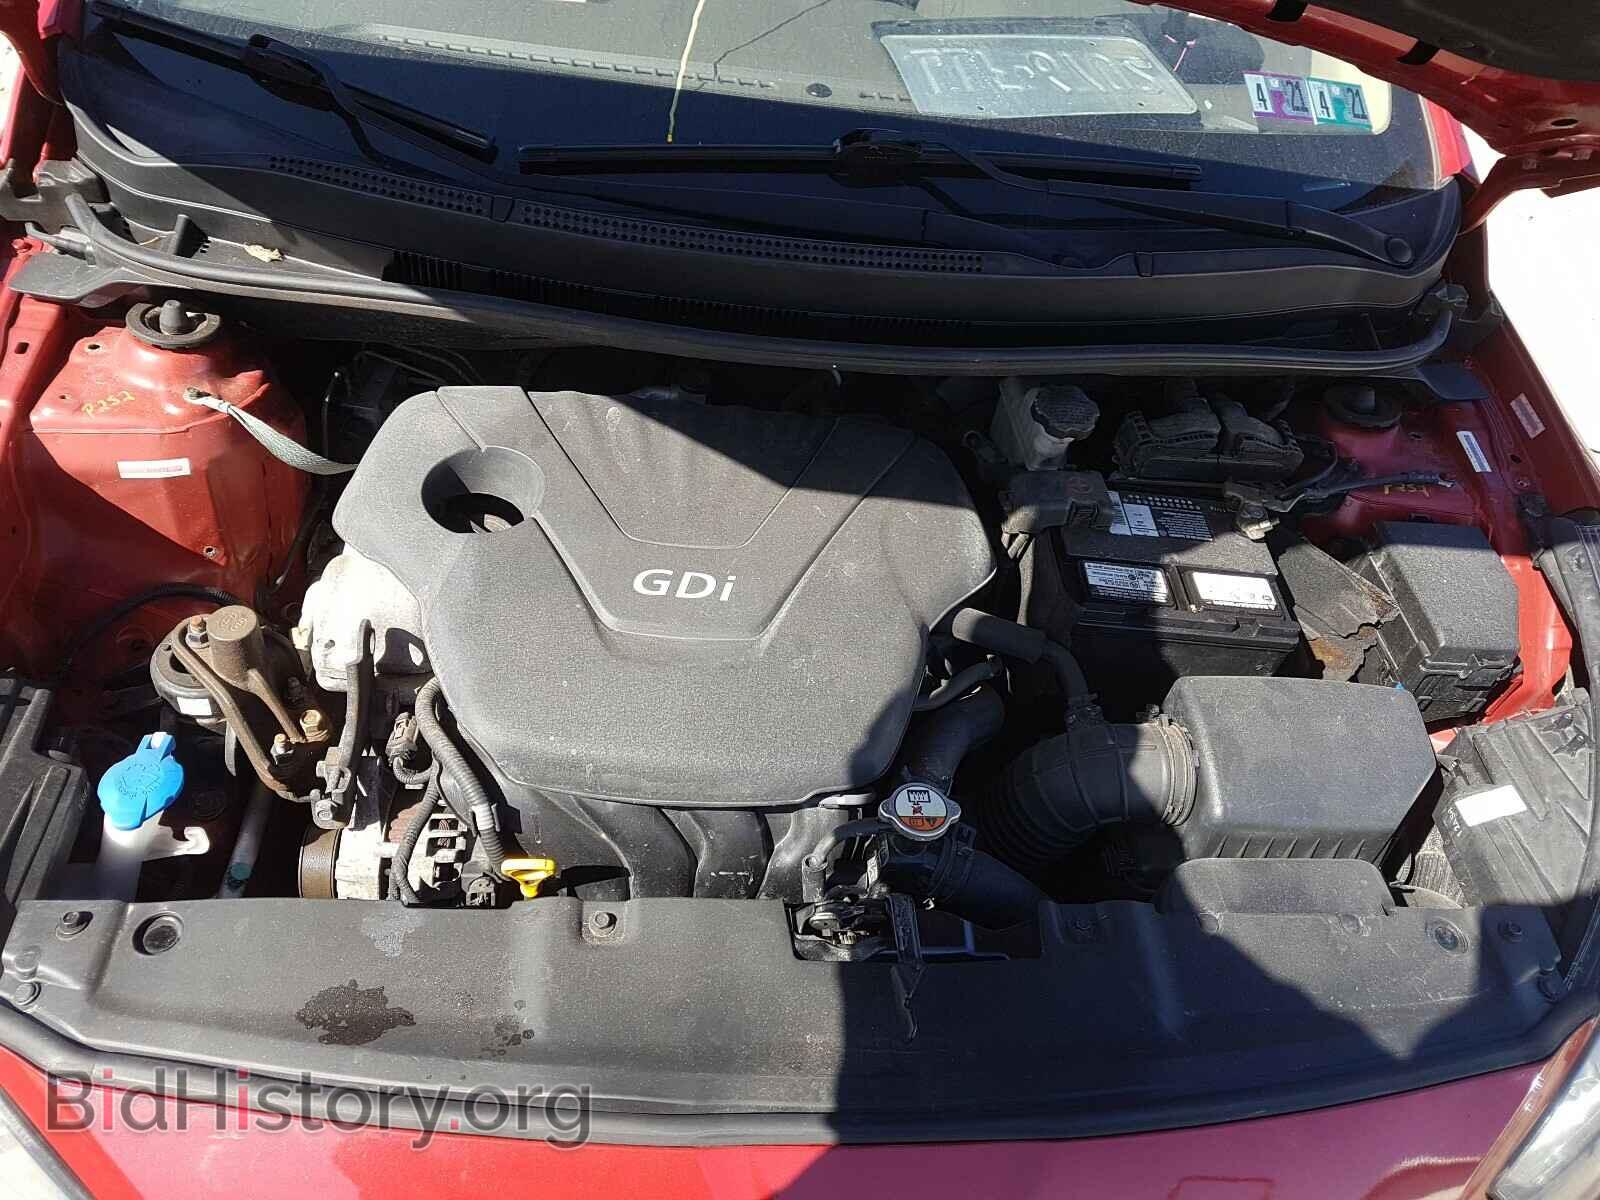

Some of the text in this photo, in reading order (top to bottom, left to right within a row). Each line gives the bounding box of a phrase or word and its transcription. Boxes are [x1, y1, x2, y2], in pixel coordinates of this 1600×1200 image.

[1256, 80, 1309, 113] 4 21
[1319, 87, 1369, 119] 4 21
[633, 568, 737, 601] GDi
